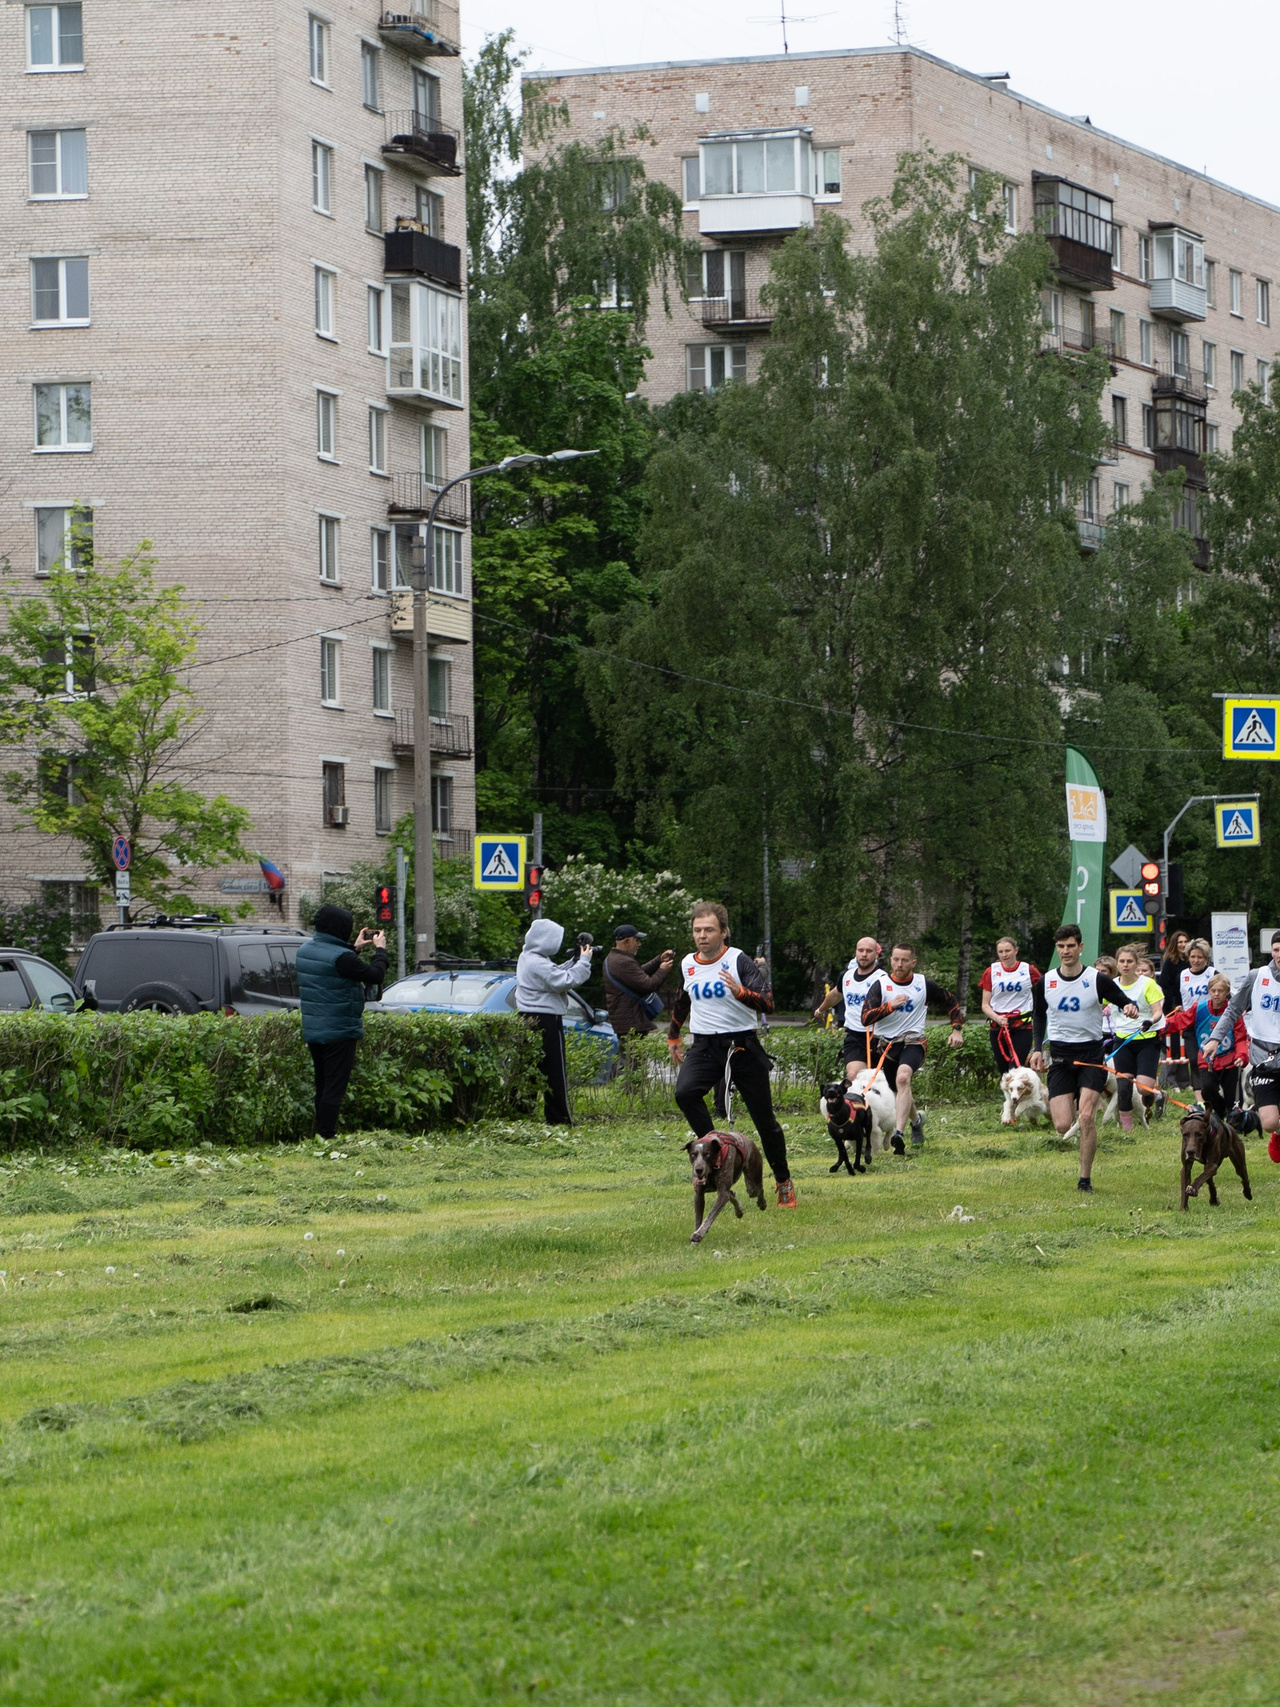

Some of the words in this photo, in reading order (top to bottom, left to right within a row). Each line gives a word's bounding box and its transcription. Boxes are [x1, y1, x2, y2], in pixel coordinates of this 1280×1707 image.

[691, 981, 726, 1000] 168
[998, 981, 1023, 992] 166
[1188, 985, 1208, 997] 143
[1058, 996, 1080, 1012] 43
[1200, 1033, 1232, 1051] 29
